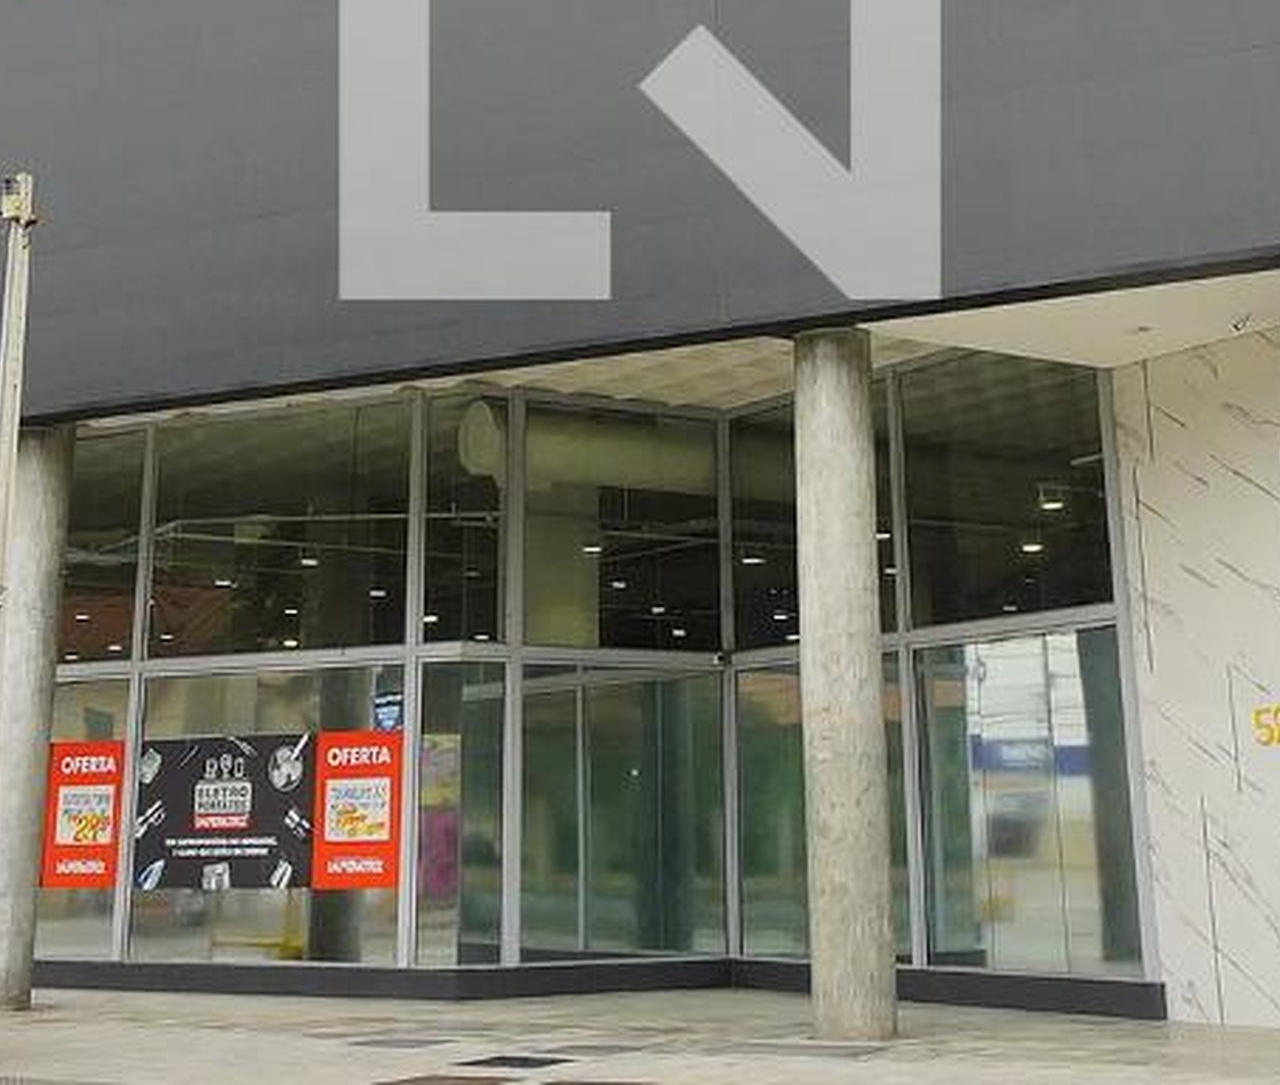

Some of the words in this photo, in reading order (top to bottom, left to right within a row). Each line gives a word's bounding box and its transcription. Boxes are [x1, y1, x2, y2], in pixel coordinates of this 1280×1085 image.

[60, 756, 117, 774] OFERTA
[327, 747, 392, 767] OFERTA
[197, 786, 249, 799] ELETRO
